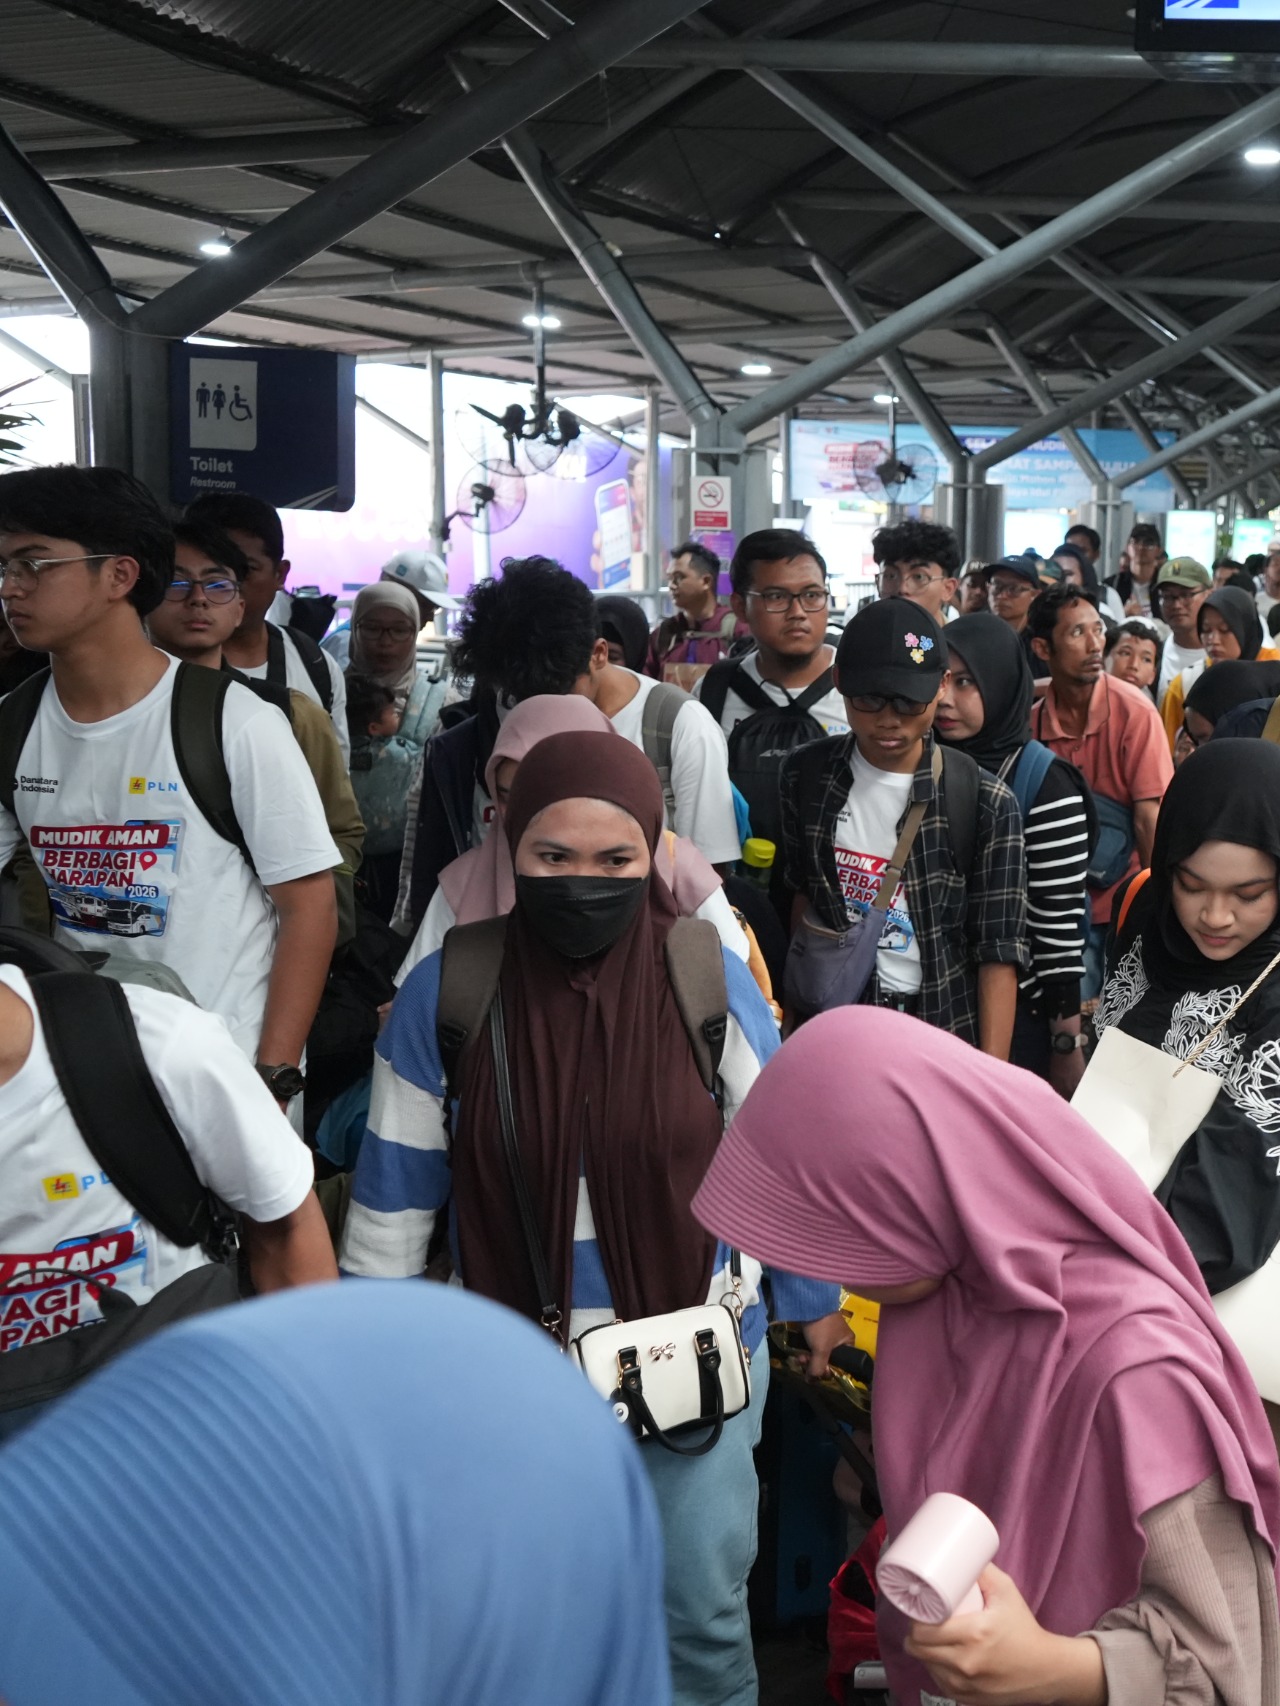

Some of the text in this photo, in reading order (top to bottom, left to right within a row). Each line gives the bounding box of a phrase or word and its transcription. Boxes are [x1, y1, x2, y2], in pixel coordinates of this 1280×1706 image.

[189, 456, 234, 473] Toilet
[189, 476, 236, 489] Restroom
[147, 782, 178, 792] PLN
[38, 829, 160, 846] MUDIK AMAN
[43, 850, 137, 870] BERBAGI
[127, 885, 157, 898] 2026
[888, 909, 910, 924] 2026
[81, 1171, 113, 1191] PL
[7, 1240, 119, 1288] AMAN
[0, 1282, 81, 1326] AGI
